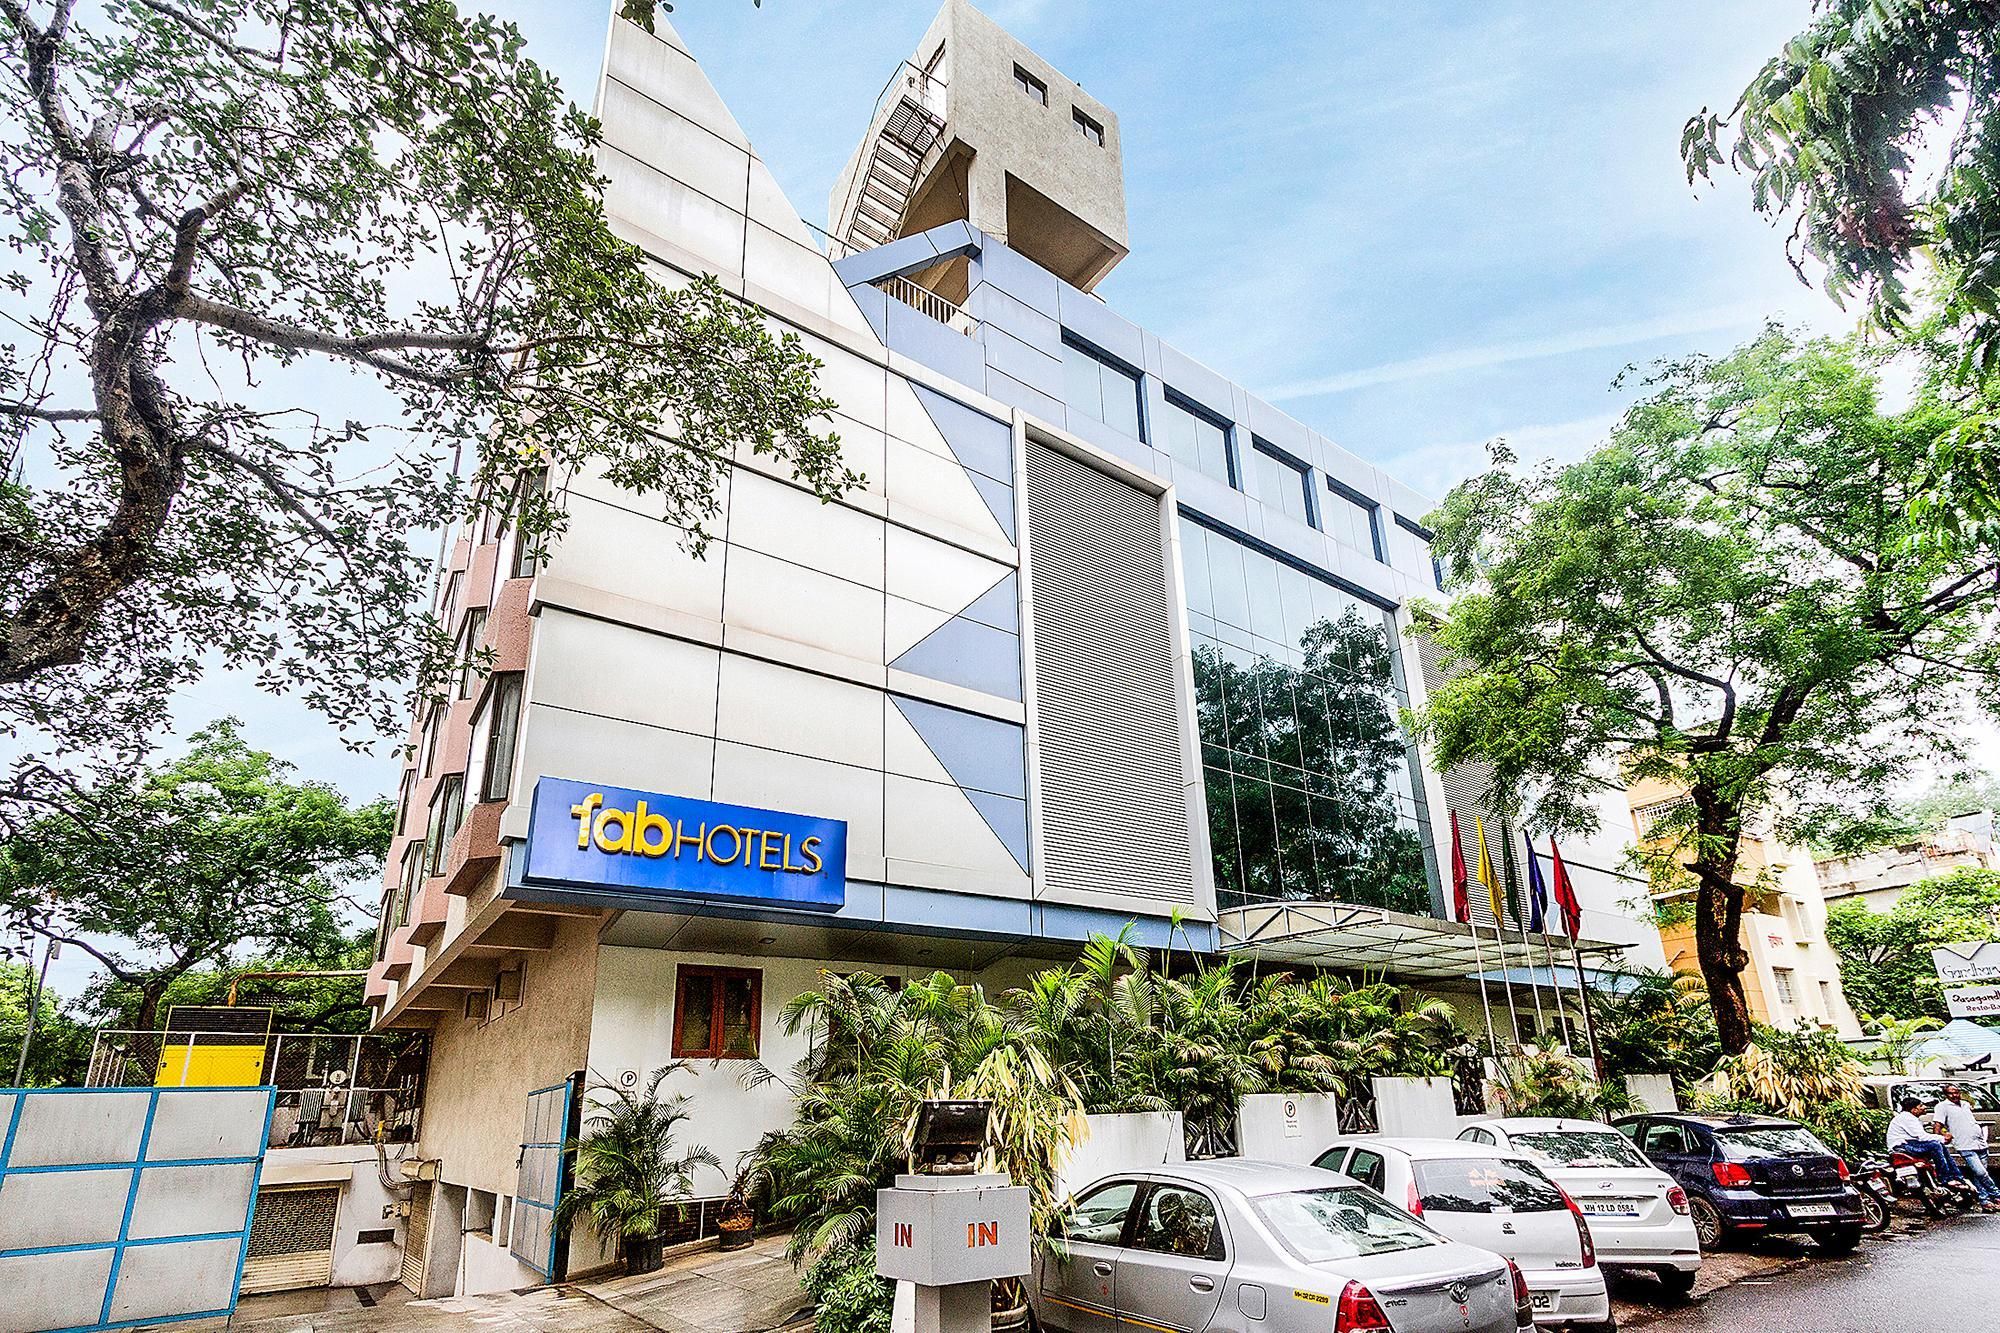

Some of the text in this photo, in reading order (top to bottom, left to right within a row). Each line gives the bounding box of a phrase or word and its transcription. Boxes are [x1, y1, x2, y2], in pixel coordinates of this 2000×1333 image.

[1584, 1204, 1596, 1212] MH
[1597, 1204, 1605, 1212] 12
[894, 1222, 913, 1249] IN
[967, 1220, 998, 1249] IN
